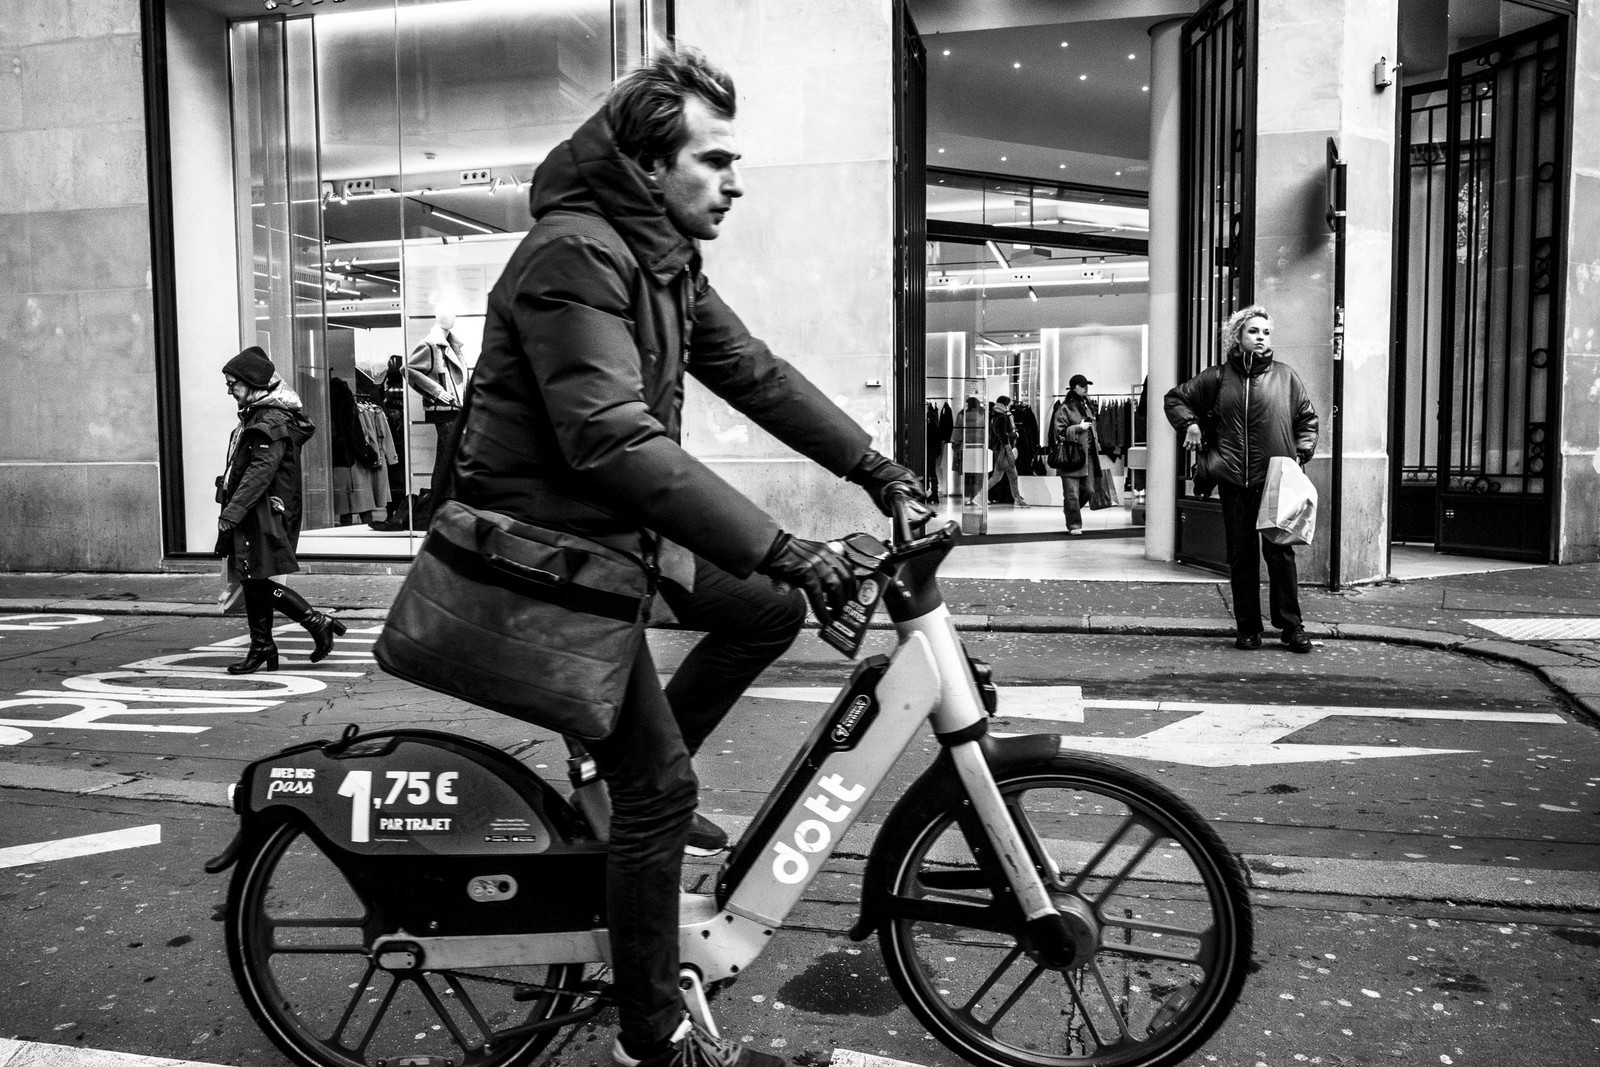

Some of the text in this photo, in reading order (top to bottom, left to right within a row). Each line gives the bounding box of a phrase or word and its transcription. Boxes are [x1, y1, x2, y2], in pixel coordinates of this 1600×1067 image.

[267, 780, 314, 800] pass
[380, 818, 452, 831] PAR TRAJET
[772, 772, 867, 885] dott
